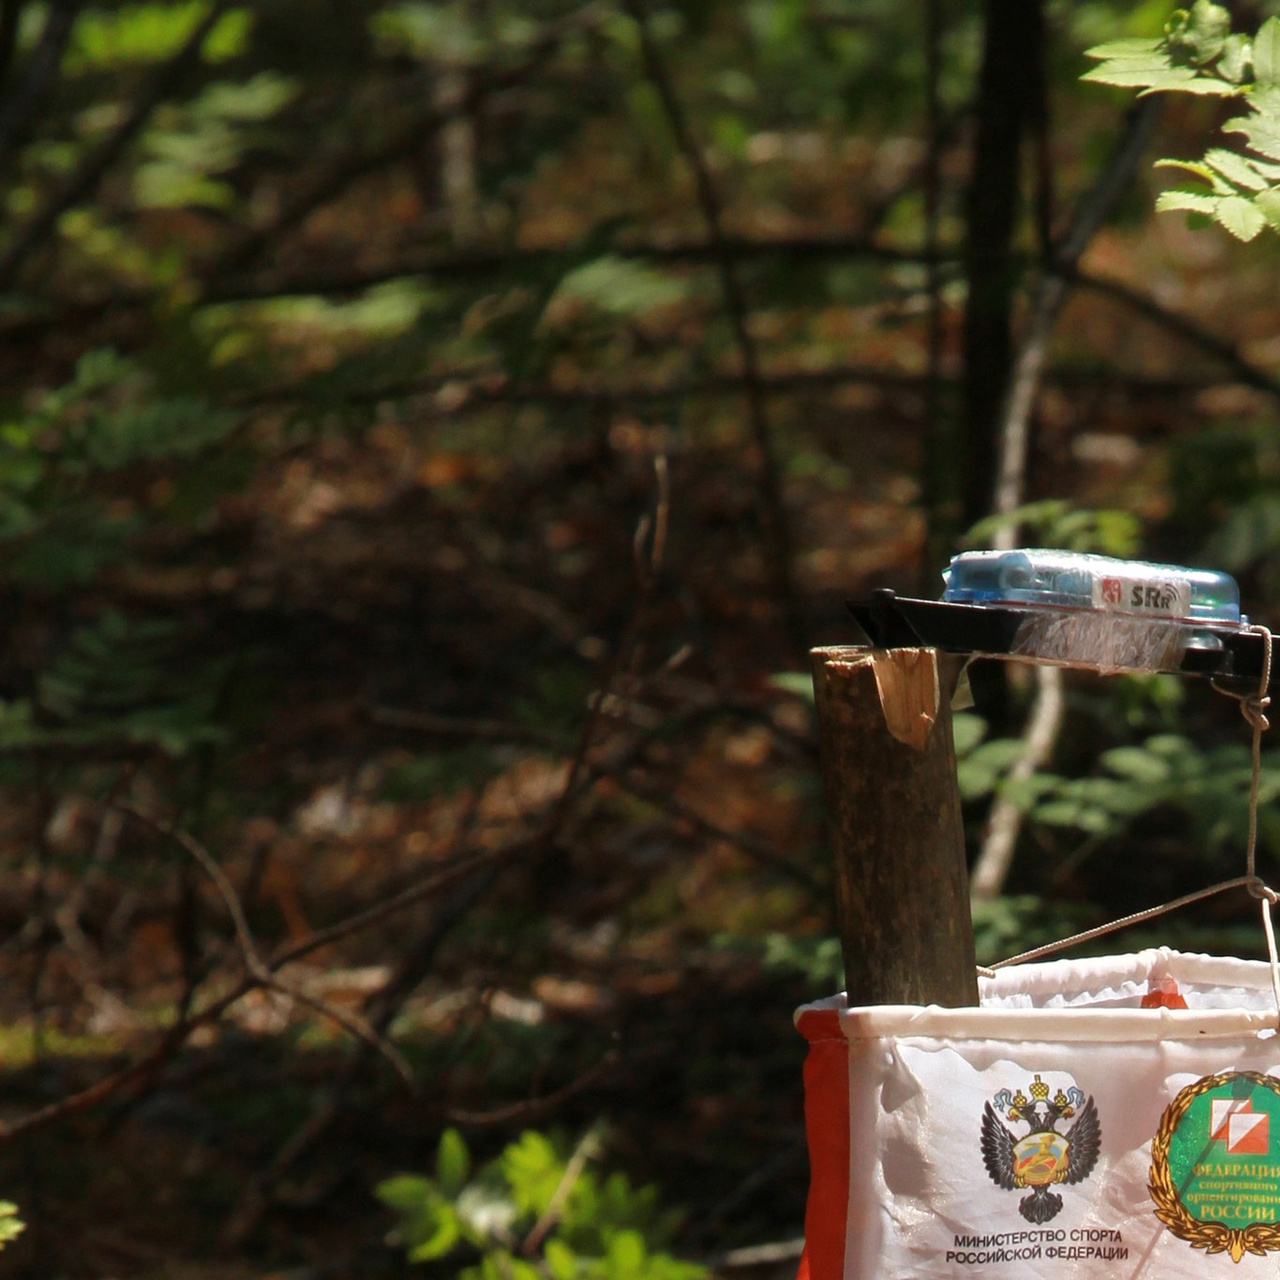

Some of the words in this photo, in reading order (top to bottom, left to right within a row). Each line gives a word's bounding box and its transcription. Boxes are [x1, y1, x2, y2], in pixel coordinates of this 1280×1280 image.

[1201, 1204, 1276, 1221] РОССИИ
[954, 1229, 1067, 1247] МИНИСТЕРСТВО
[1069, 1229, 1123, 1242] СПОРТА
[945, 1245, 1042, 1264] РОССИЙСКОЙ
[1044, 1246, 1129, 1261] ФЕДЕРАЦИИ
